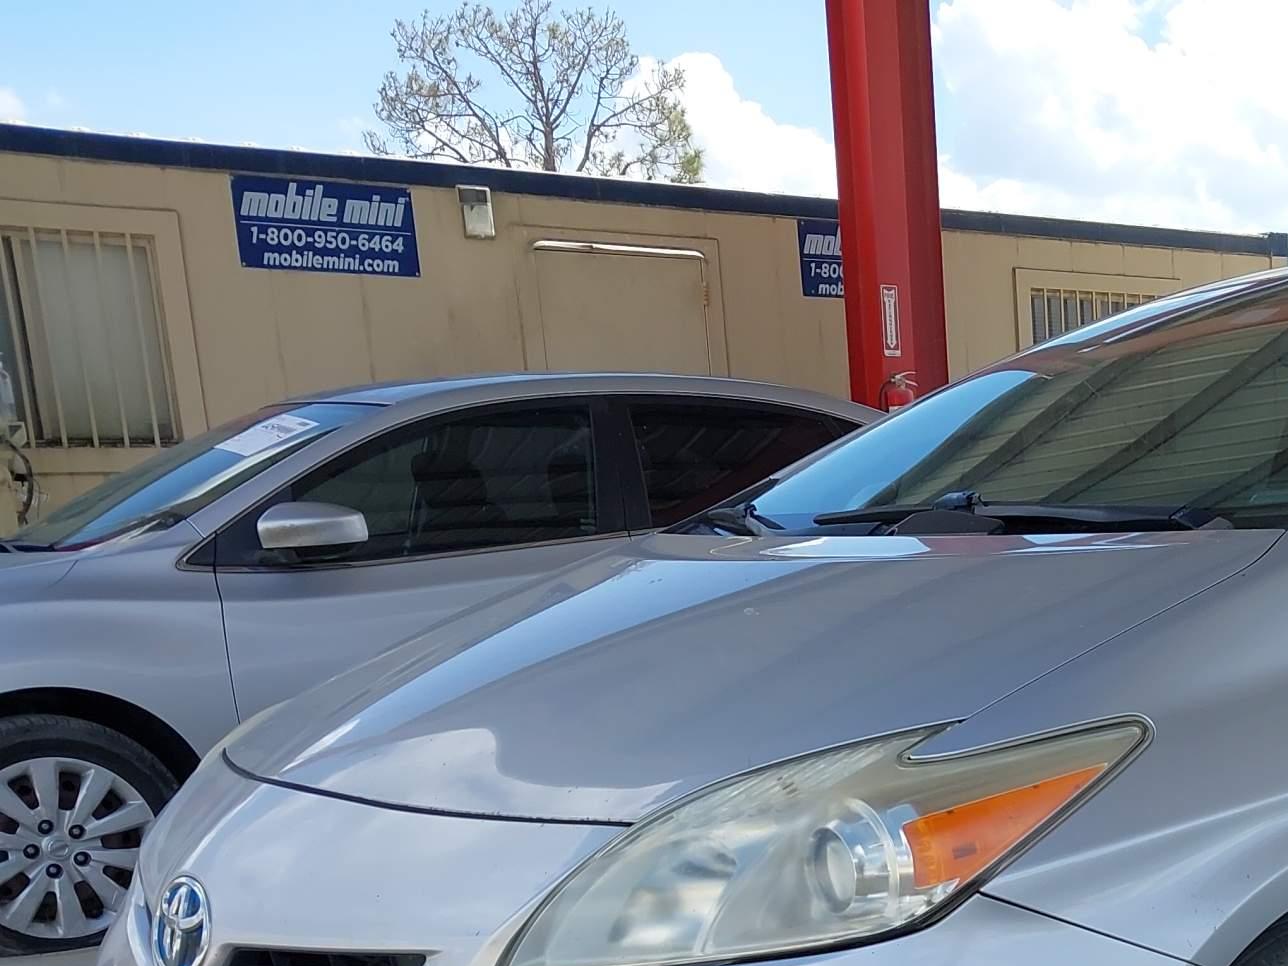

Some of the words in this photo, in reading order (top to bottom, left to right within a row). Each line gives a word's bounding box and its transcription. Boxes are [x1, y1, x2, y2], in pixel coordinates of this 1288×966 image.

[240, 182, 338, 222] mobile
[343, 195, 406, 227] mini
[250, 226, 404, 253] 1-800-950-6464
[263, 250, 399, 273] mobilemini.com
